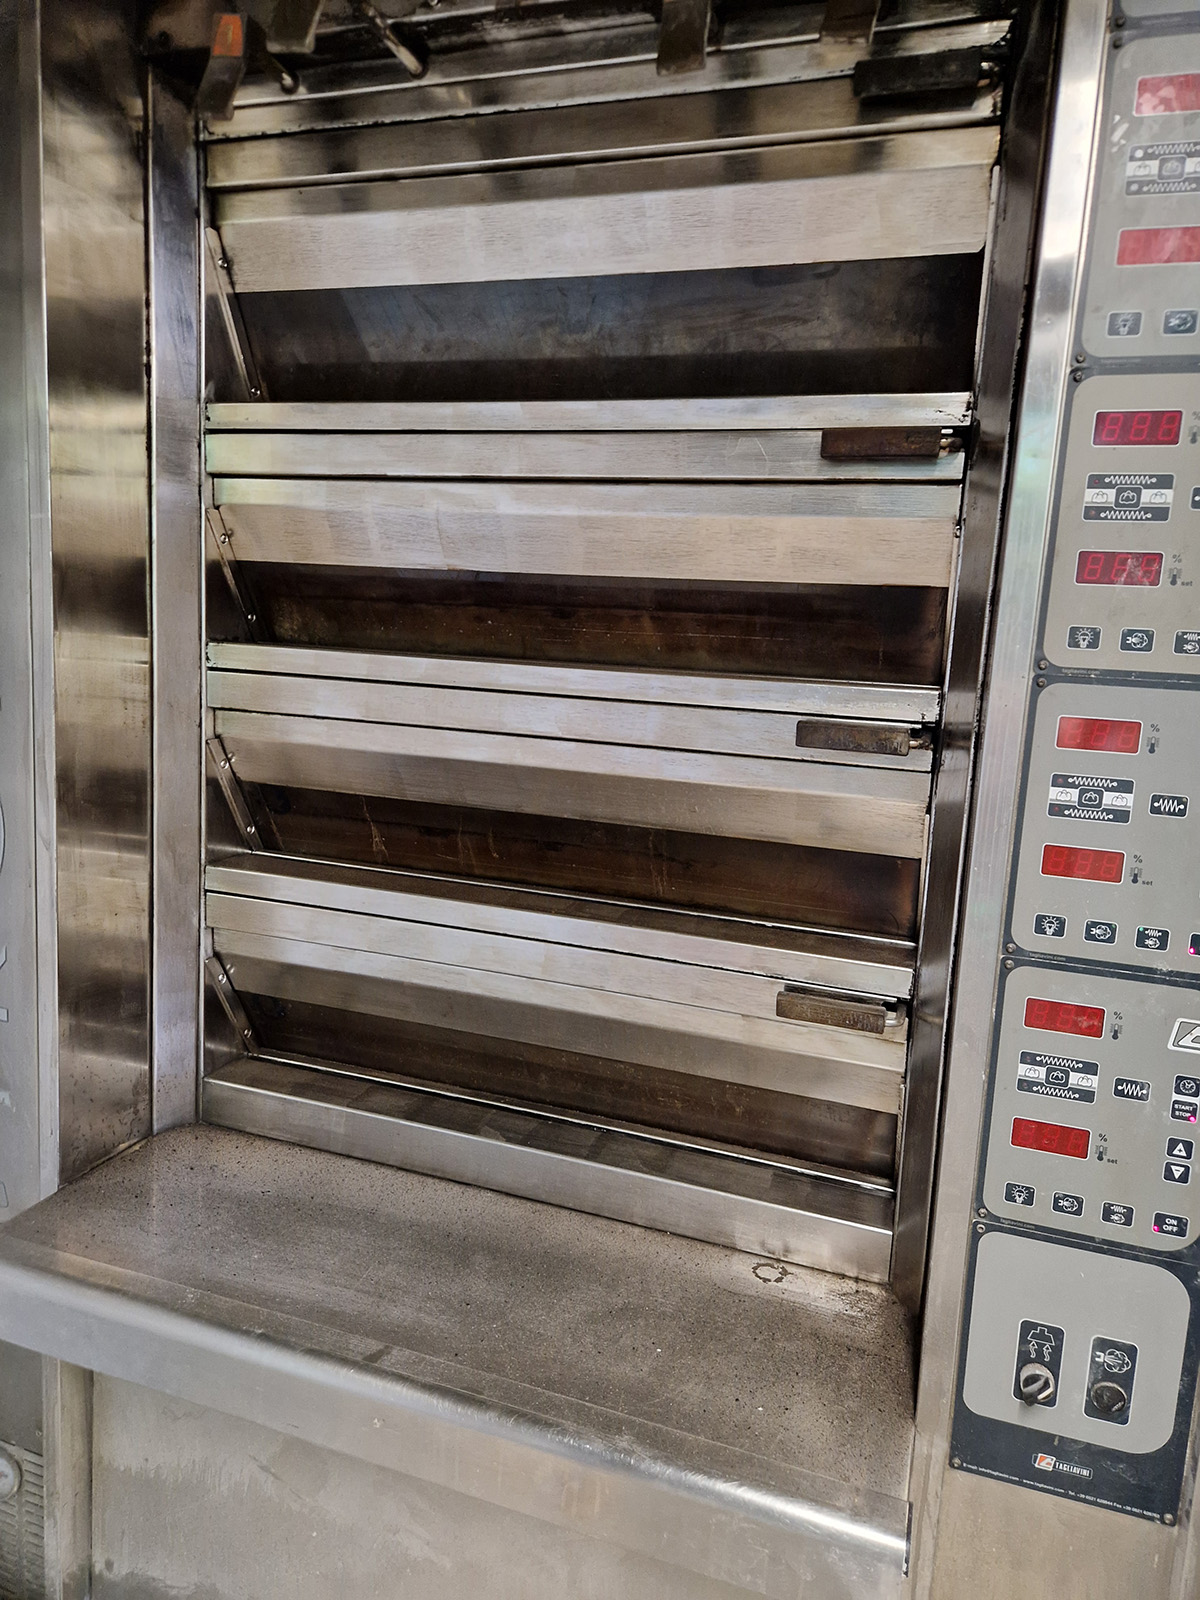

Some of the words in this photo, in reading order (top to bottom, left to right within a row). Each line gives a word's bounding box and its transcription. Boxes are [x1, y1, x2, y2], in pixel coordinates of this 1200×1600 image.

[1141, 879, 1153, 887] set
[1174, 1103, 1193, 1111] START
[1175, 1110, 1191, 1118] STOP
[1106, 1157, 1118, 1165] set
[1165, 1218, 1178, 1226] ON
[1162, 1224, 1179, 1233] OFF
[1055, 1461, 1090, 1477] TAGLIAVINI
